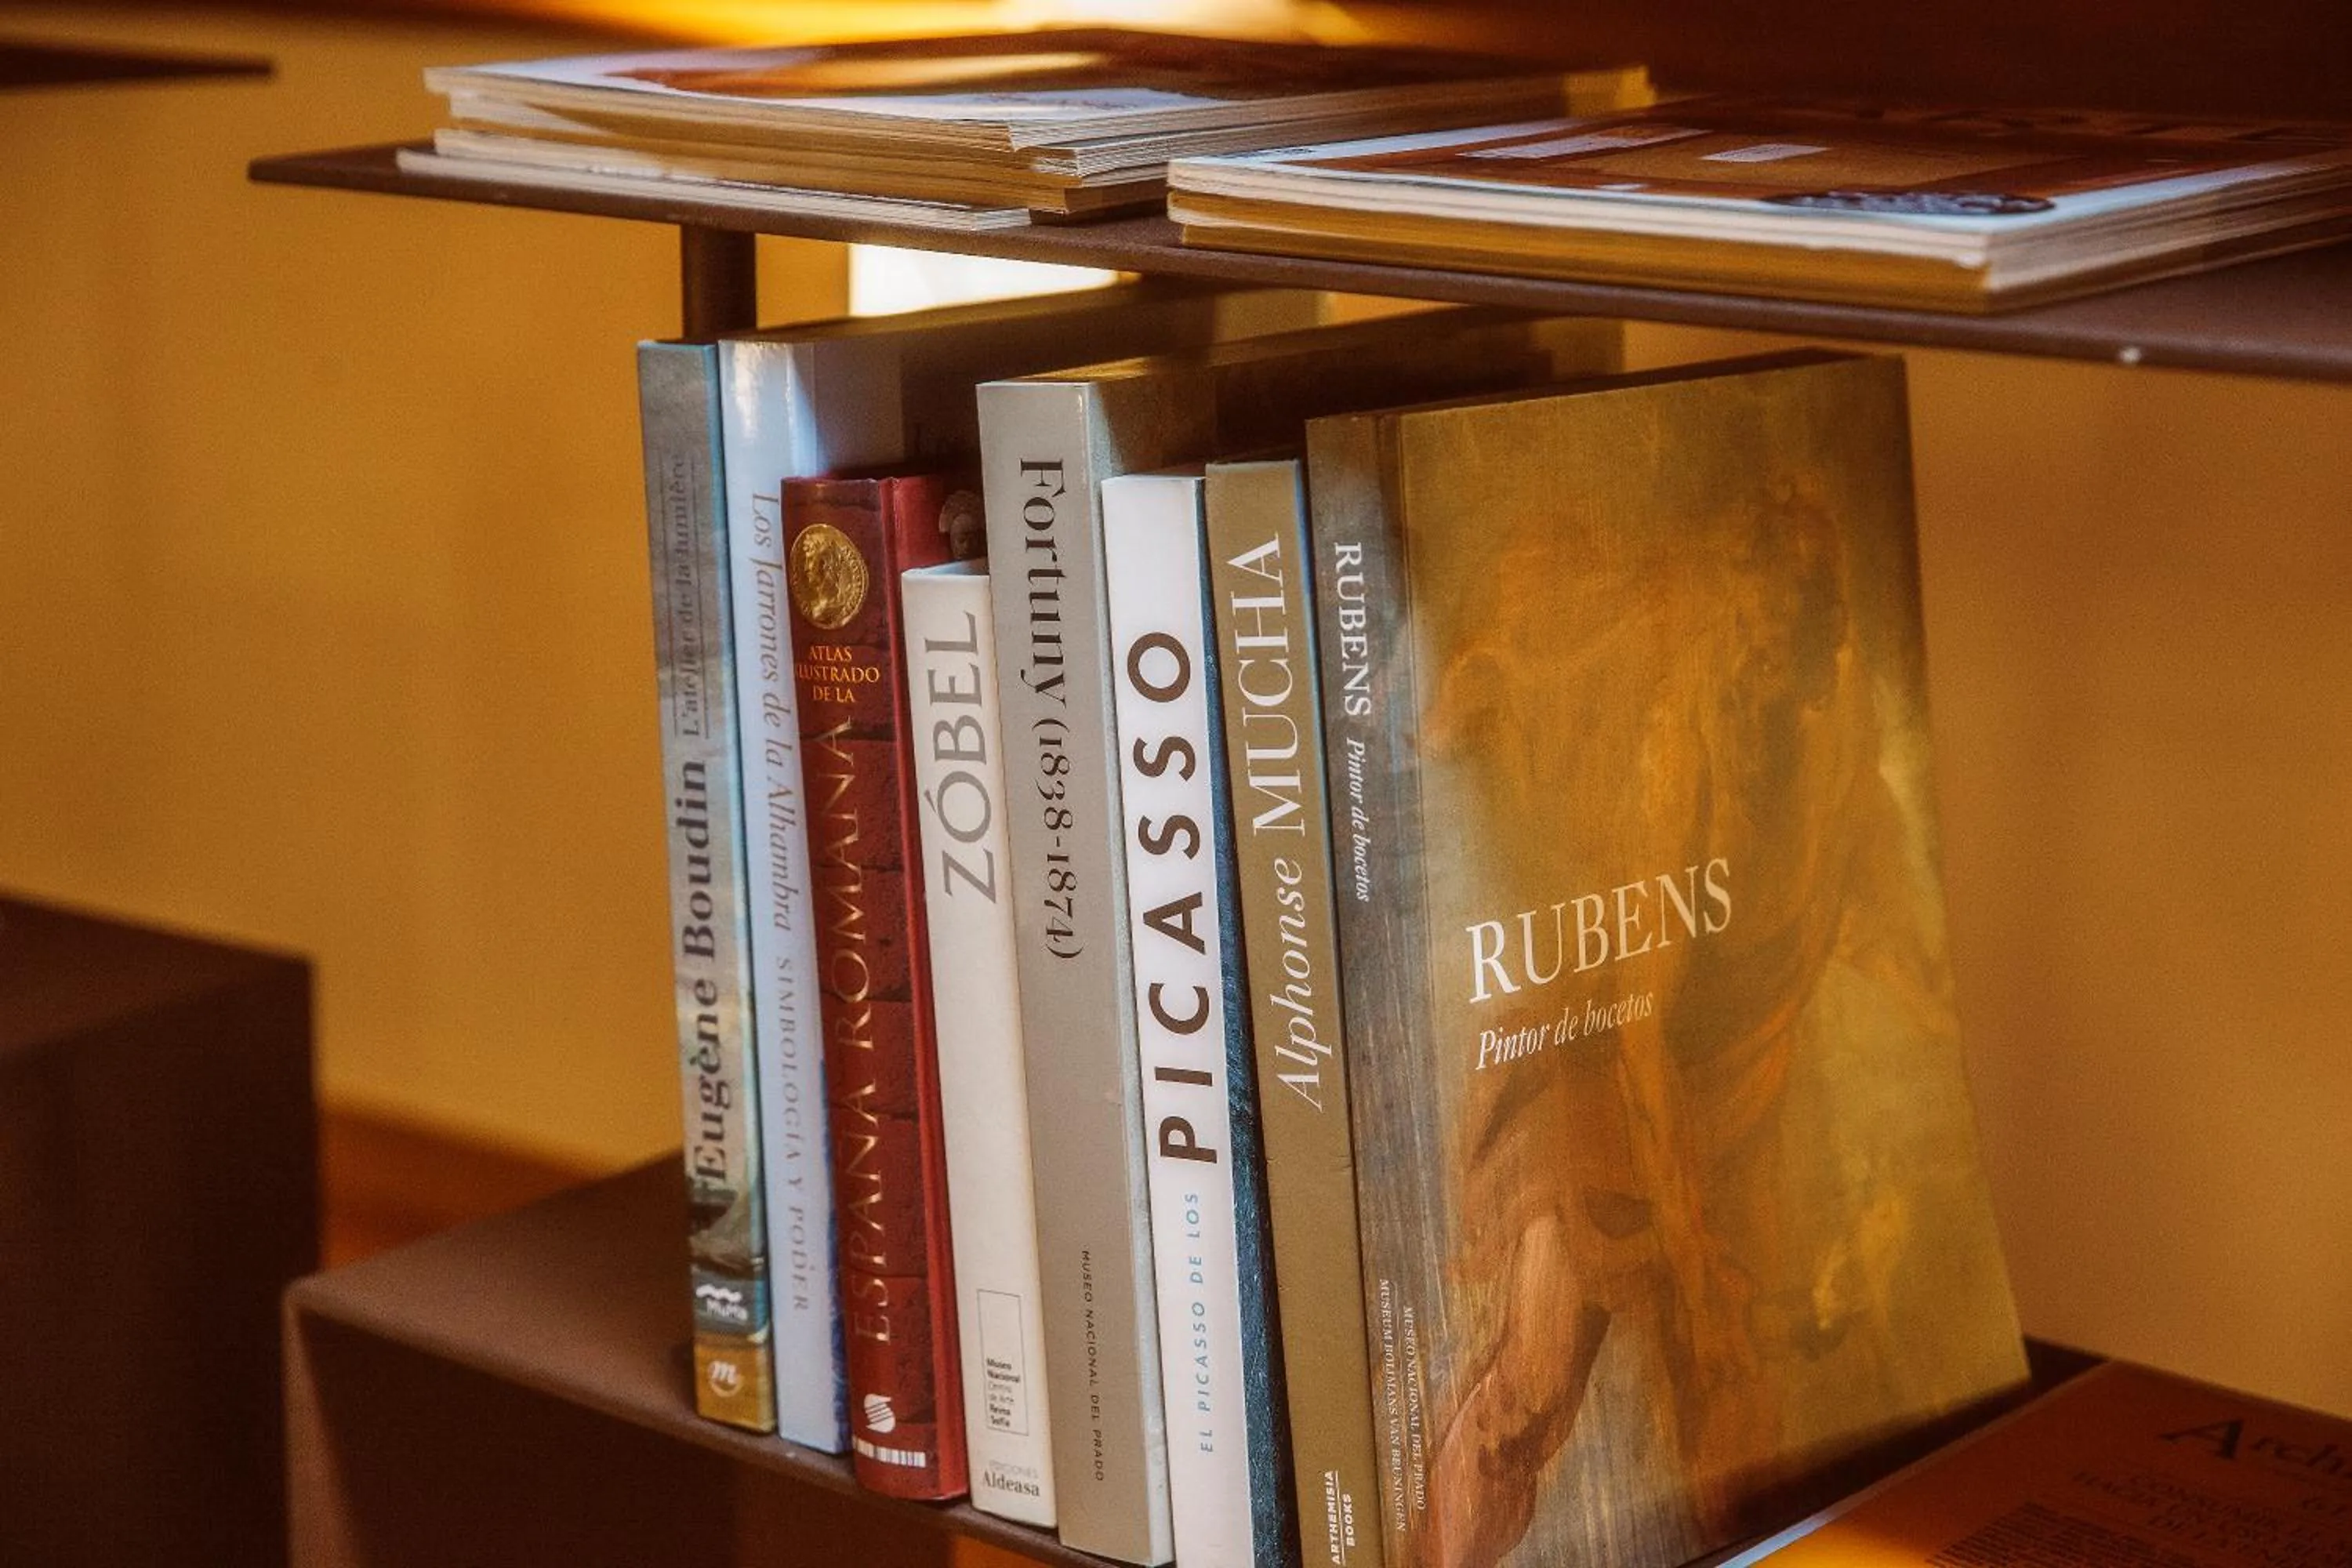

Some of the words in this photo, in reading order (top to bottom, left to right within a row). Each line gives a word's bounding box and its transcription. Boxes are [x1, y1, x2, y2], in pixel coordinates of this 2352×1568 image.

[753, 492, 781, 548] Los
[1020, 458, 1067, 709] Fortuny
[809, 645, 852, 662] ATLAS
[1334, 542, 1372, 717] RUBENS
[763, 692, 792, 728] de
[813, 686, 833, 702] DE
[837, 688, 856, 702] LA
[1226, 532, 1305, 837] MUCHA
[765, 739, 793, 767] la
[924, 611, 996, 903] ZÓBEL
[1346, 738, 1364, 804] Pintor
[1032, 718, 1083, 959] (1838-1874)
[1349, 807, 1370, 829] de
[675, 760, 714, 964] Boudin
[766, 775, 800, 931] Alhambra
[815, 716, 873, 1050] ROMANA
[1351, 832, 1372, 902] bocetos
[1127, 632, 1218, 1163] PICASSO
[1466, 858, 1732, 1004] RUBENS
[1270, 856, 1330, 1113] Alphonse
[1475, 1022, 1551, 1070] Pintor
[1555, 1007, 1579, 1045] de
[1584, 991, 1653, 1036] bocetos
[690, 978, 730, 1183] Eugène
[786, 1176, 804, 1190] Y
[1185, 1193, 1201, 1239] LOS
[1081, 1250, 1093, 1303] MUSEO
[1189, 1256, 1203, 1284] DE
[1085, 1310, 1098, 1386] NACIONAL
[1192, 1301, 1211, 1413] PICASSO
[1380, 1279, 1393, 1341] MUSEUM
[1389, 1418, 1400, 1446] VAN
[1403, 1305, 1416, 1357] MUSEO
[1091, 1395, 1100, 1422] DEL
[1200, 1429, 1214, 1454] EL
[1093, 1429, 1104, 1482] PRADO
[1411, 1434, 1421, 1458] DEL
[983, 1470, 1041, 1497] Aldeasa
[1414, 1465, 1426, 1511] PRADO
[1324, 1470, 1341, 1566] ARTHEMISIA
[1342, 1493, 1356, 1547] BOOKS
